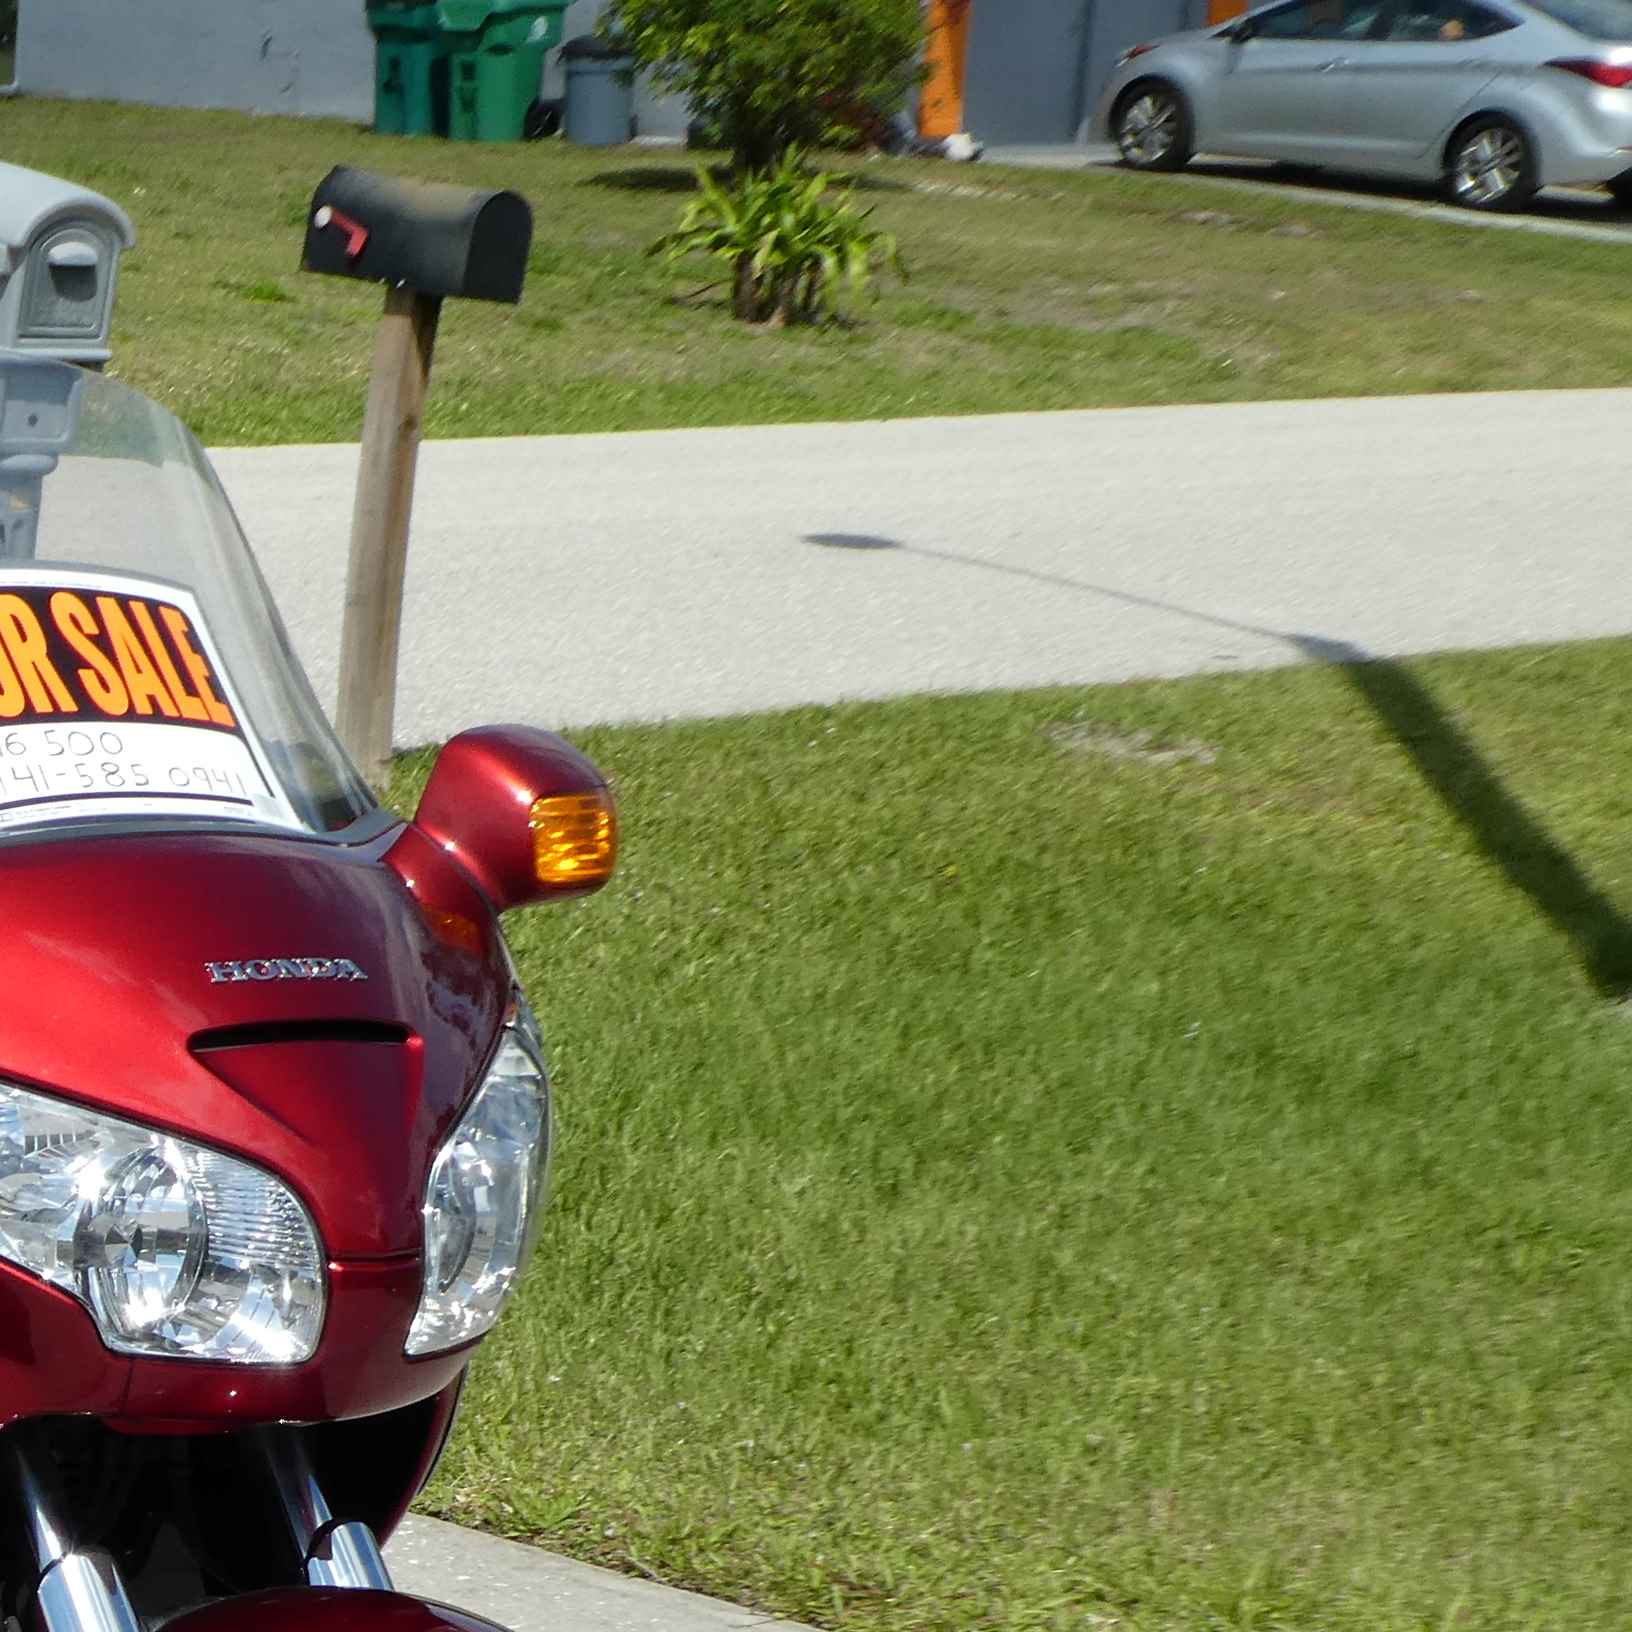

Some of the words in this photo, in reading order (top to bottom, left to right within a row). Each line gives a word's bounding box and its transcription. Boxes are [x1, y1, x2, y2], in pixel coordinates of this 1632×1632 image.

[50, 591, 236, 728] SALE
[44, 729, 124, 756] 500
[168, 766, 247, 796] 0941
[204, 957, 369, 983] HONDA
